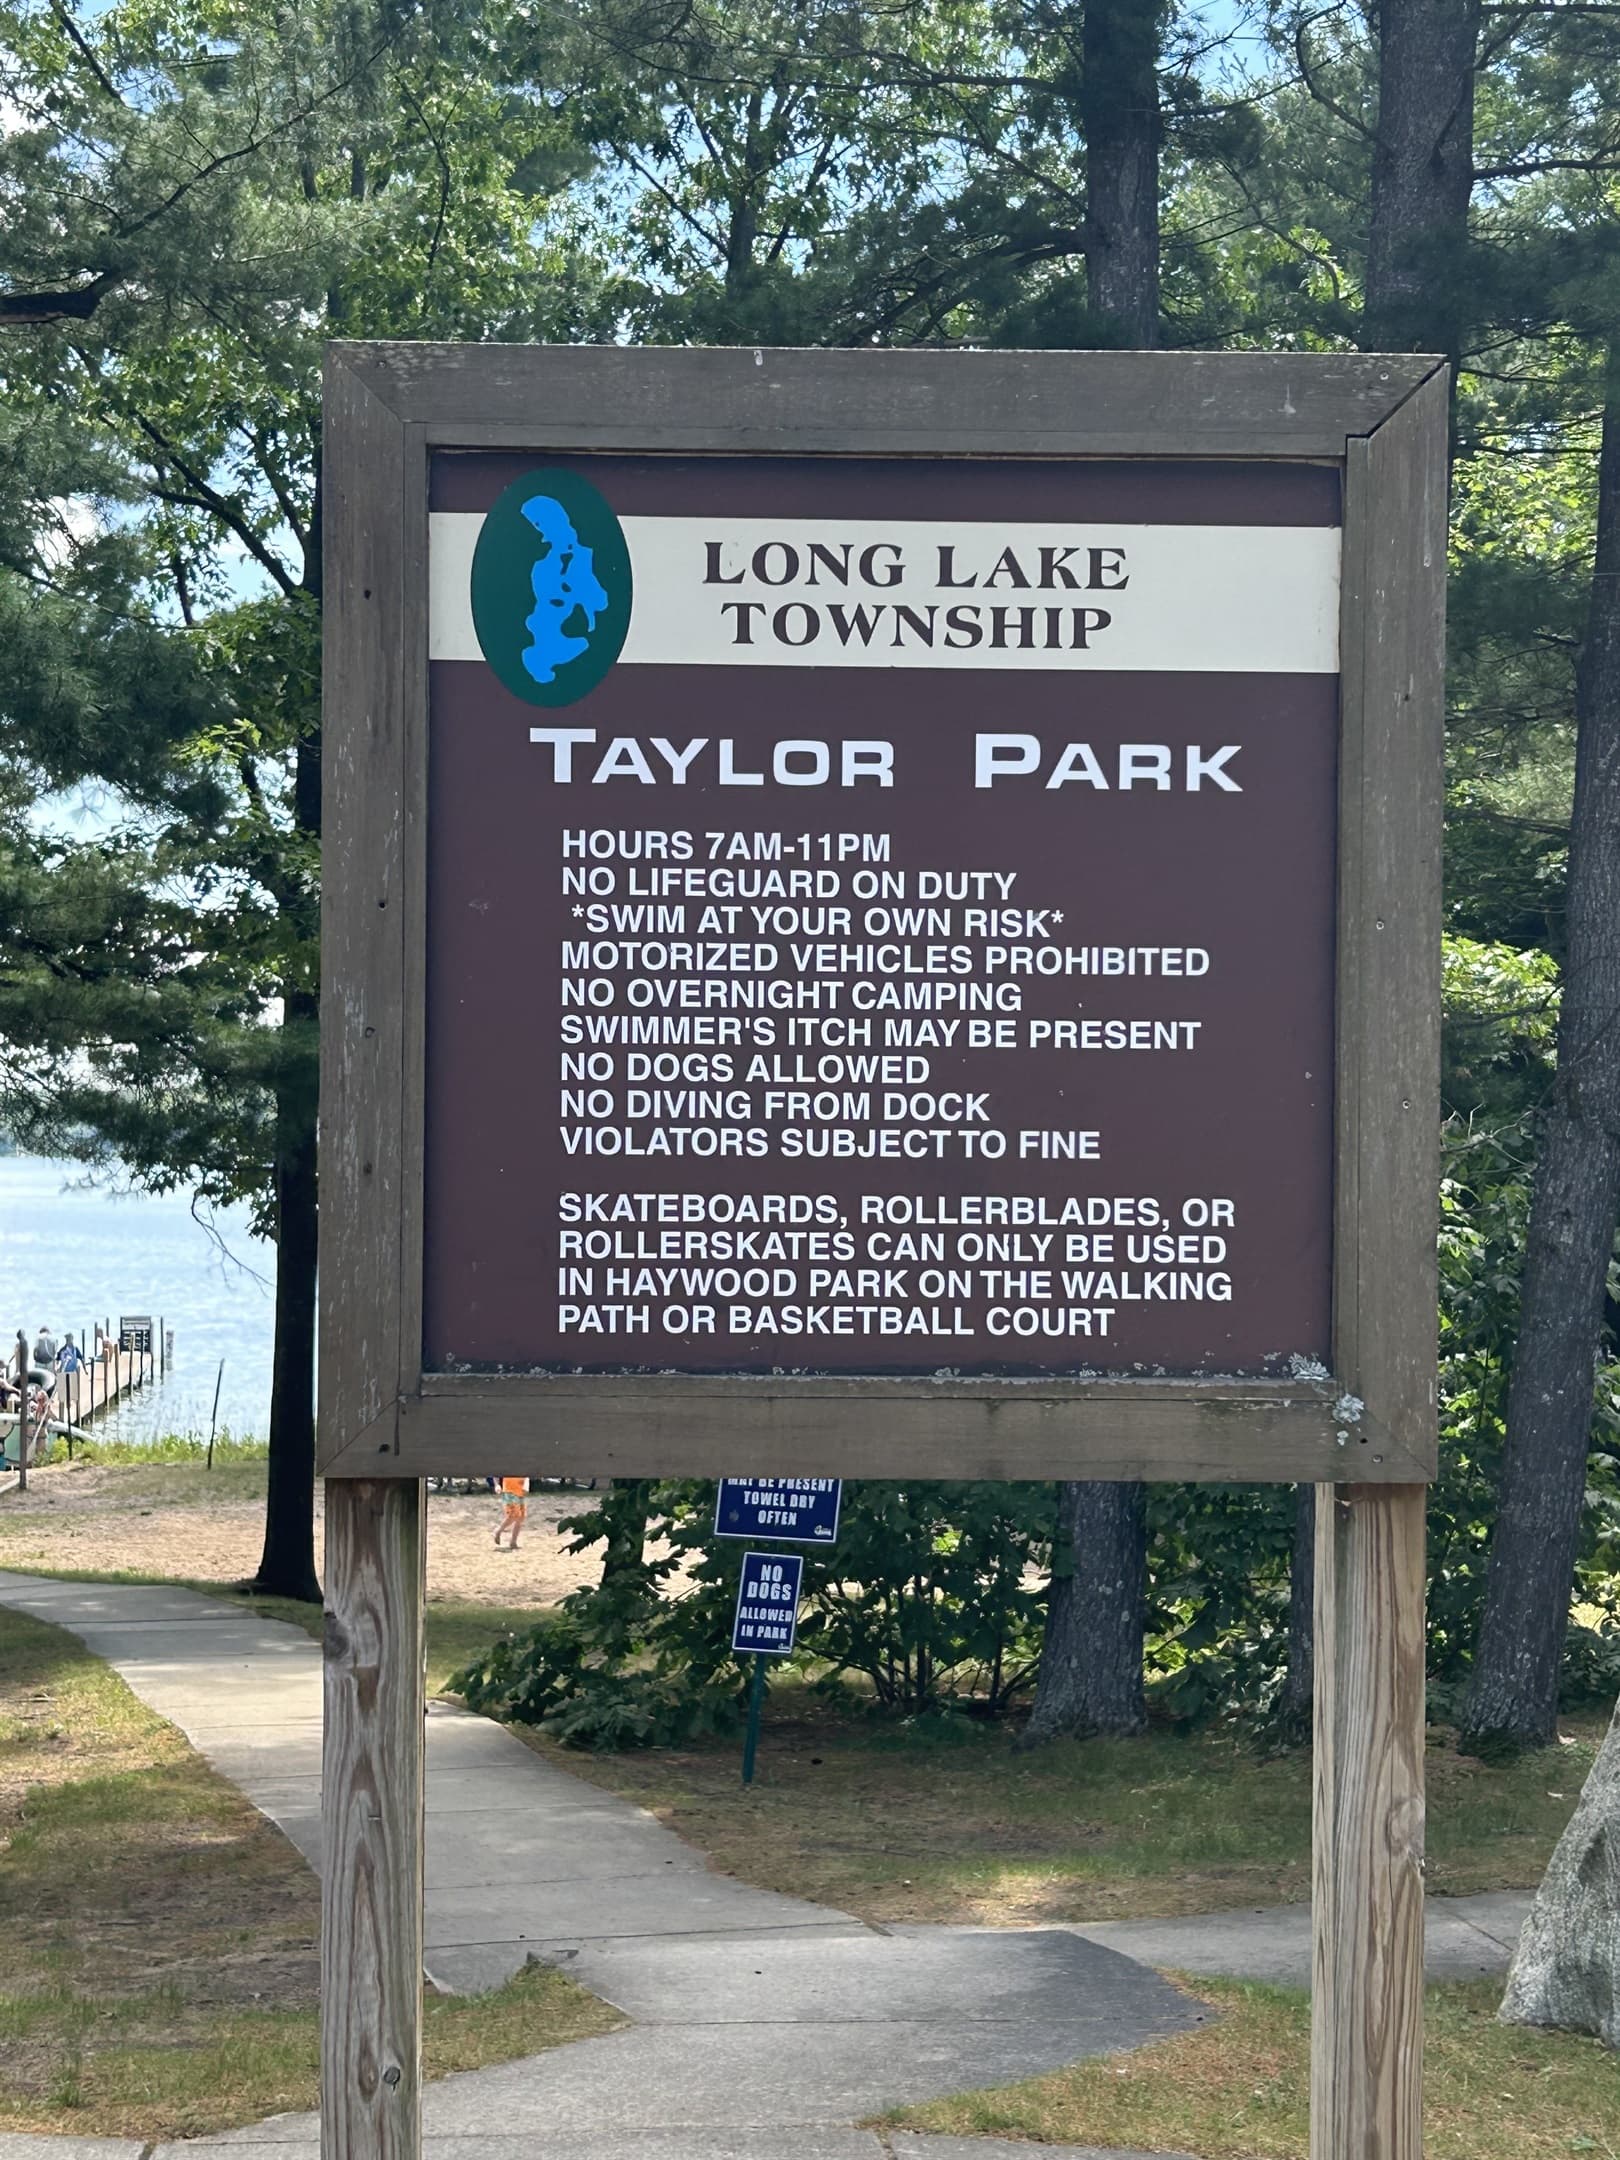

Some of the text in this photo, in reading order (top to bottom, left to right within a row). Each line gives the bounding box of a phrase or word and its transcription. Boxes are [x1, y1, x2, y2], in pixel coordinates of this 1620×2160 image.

[702, 541, 1130, 591] LONG LAKE
[720, 602, 1112, 650] TOWNSHIP
[529, 727, 1243, 792] TAYLOR PARK
[562, 829, 890, 862] HOURS 7AM-11PM
[562, 866, 1017, 901] NO LIFEGUARD ON DUTY
[697, 905, 743, 934] AT
[750, 905, 852, 936] YOUR
[864, 907, 951, 937] OWN
[562, 940, 1210, 976] MOTORIZED VEHICLES PROHIBITED
[561, 977, 1022, 1012] NO OVERNIGHT CAMPING
[560, 1014, 1202, 1050] SWIMMER'S ITCH MAY BE PRESENT
[561, 1051, 930, 1084] NO DOGS ALLOWED
[561, 1089, 991, 1122] NO DIVING FROM DOCK
[559, 1126, 1101, 1160] VIOLATORS SUBJECT TO FINE
[558, 1192, 1235, 1232] SKATEBOARDS, ROLLERBLADES, OR
[559, 1230, 1227, 1264] ROLLERSKATES CAN ONLY BE USED
[558, 1267, 1232, 1302] IN HAYWOOD PARK ON THE WALKING
[558, 1304, 1116, 1337] PATH OR BASKETBALL COURT
[744, 1490, 816, 1509] TOWEL DRY
[778, 1478, 835, 1492] PRESENT
[757, 1510, 797, 1526] OFTEN
[760, 1564, 783, 1582] NO
[746, 1581, 792, 1601] DOGS
[740, 1606, 793, 1622] ALLOWED
[740, 1624, 788, 1640] IN PARK
